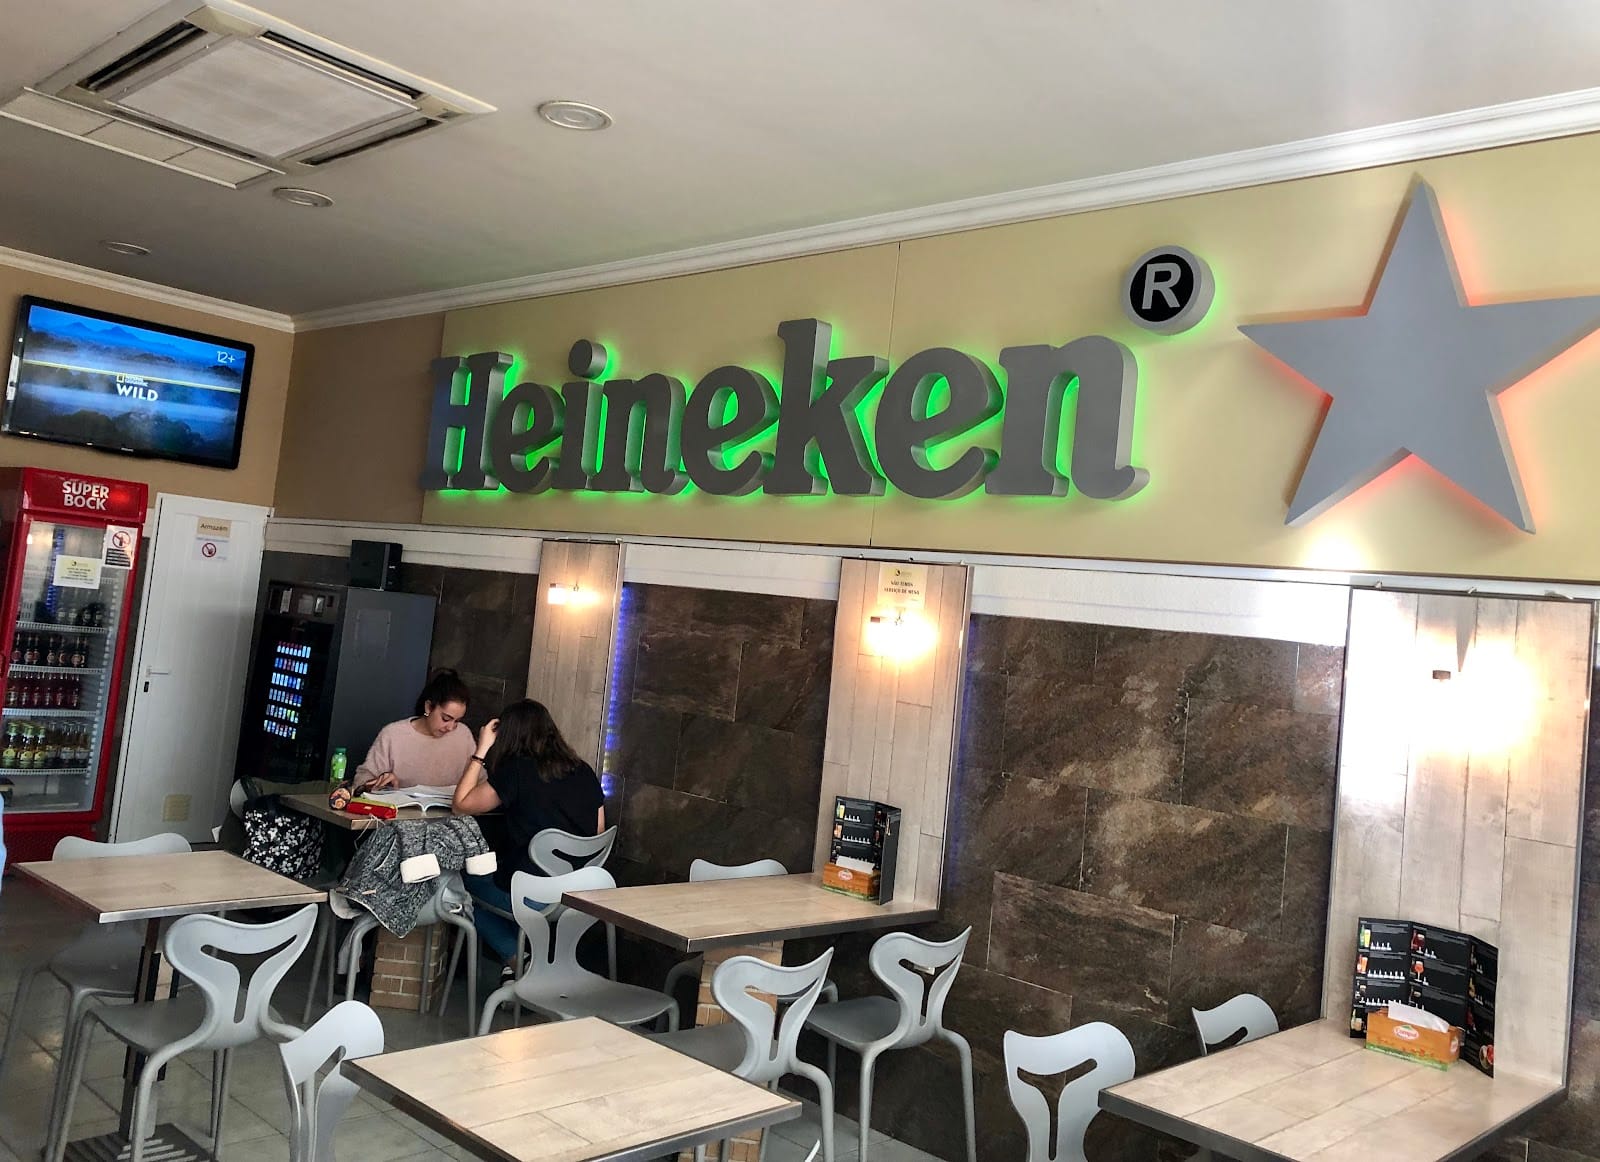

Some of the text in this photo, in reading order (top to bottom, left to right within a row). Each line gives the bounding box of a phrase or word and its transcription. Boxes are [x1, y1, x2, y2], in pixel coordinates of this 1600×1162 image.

[216, 350, 236, 364] 12+
[116, 383, 159, 402] WILD
[420, 317, 1150, 501] Heineken
[62, 480, 110, 499] SUPER
[63, 493, 107, 511] BOCK
